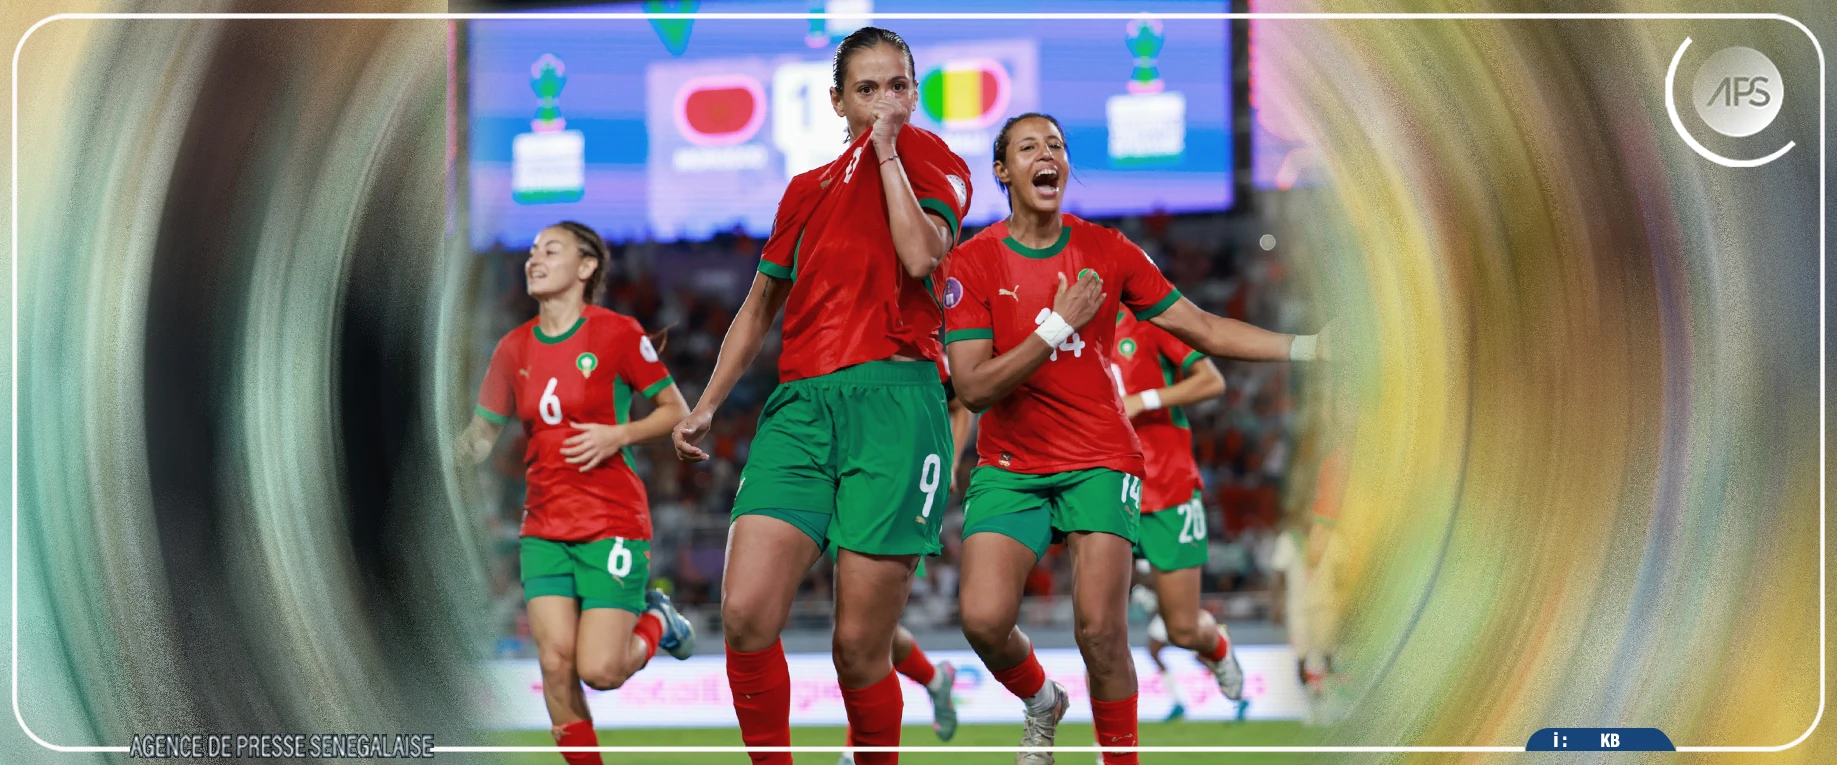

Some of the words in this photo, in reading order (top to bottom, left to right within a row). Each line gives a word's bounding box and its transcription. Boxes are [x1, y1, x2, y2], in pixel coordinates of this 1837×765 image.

[539, 377, 563, 425] 6
[919, 453, 941, 518] 9
[1121, 472, 1141, 509] 14
[1177, 497, 1207, 544] 20
[607, 536, 632, 578] 6
